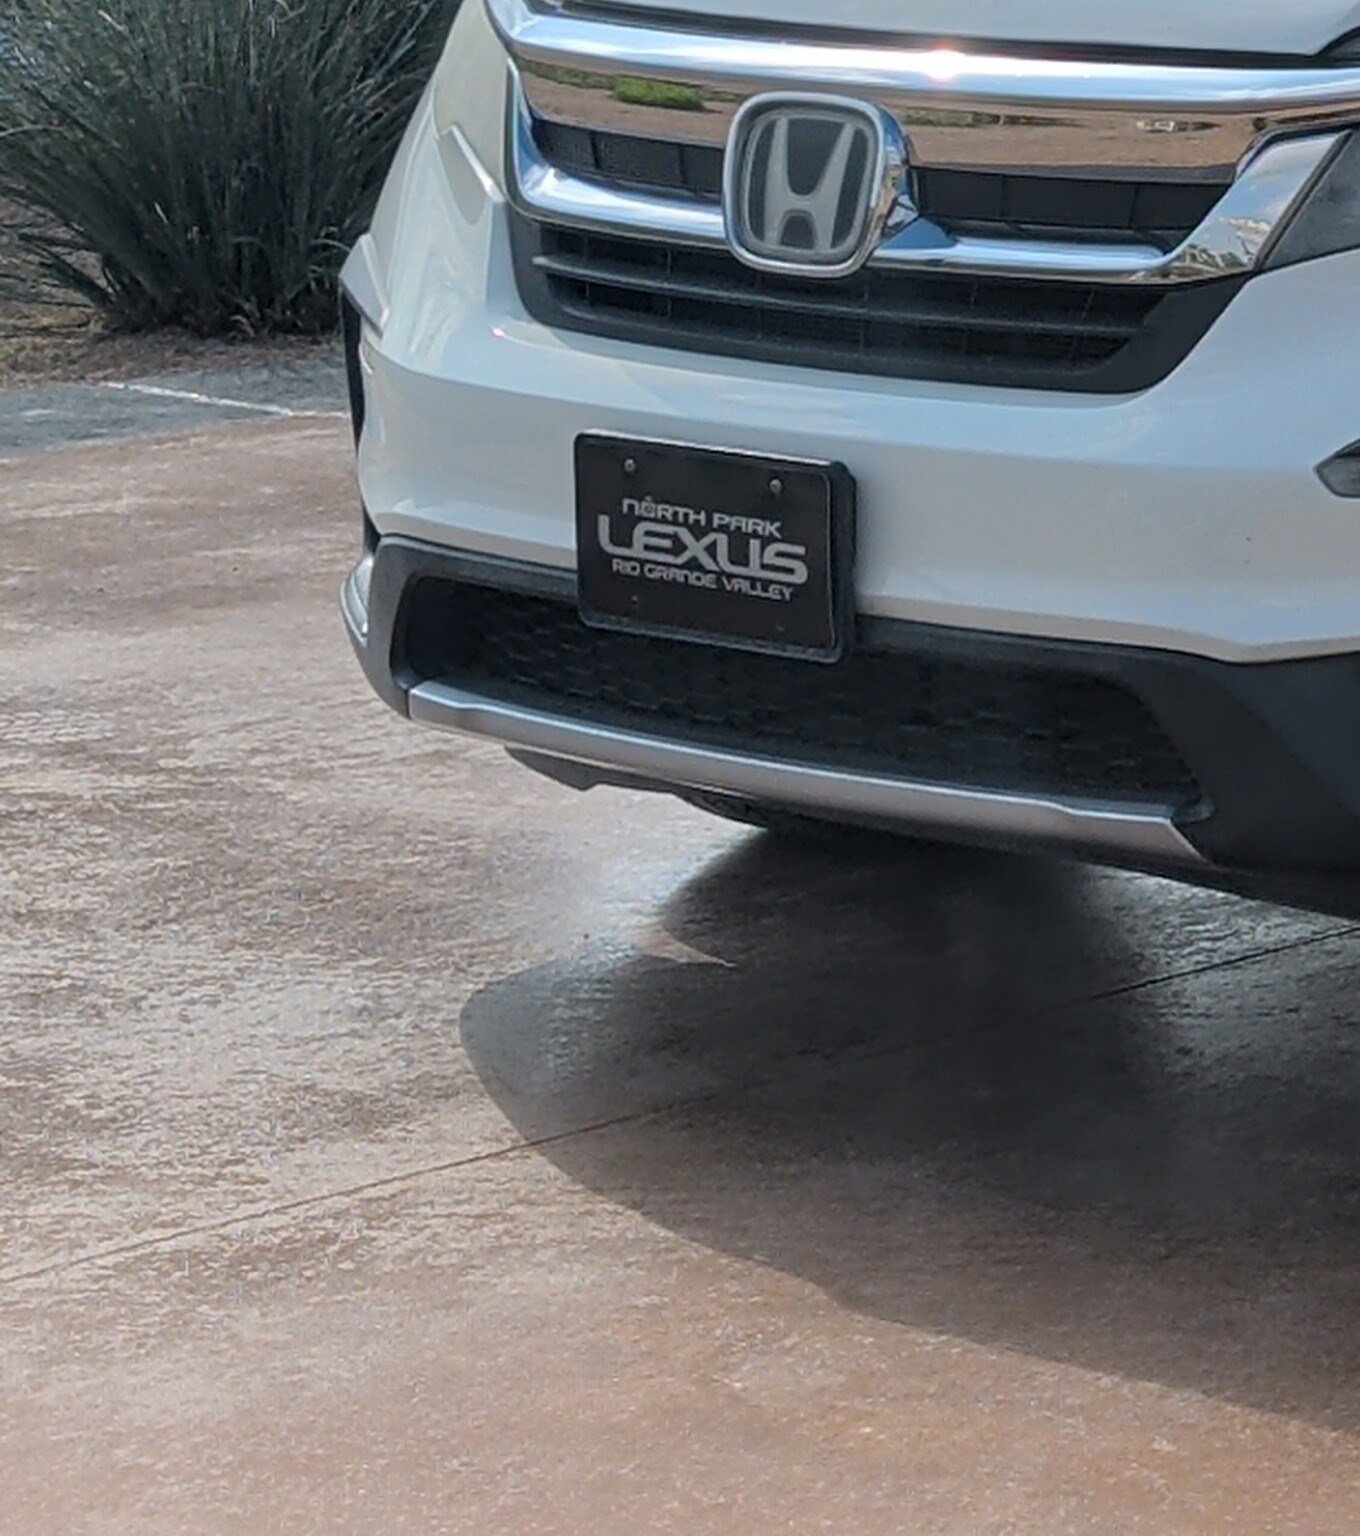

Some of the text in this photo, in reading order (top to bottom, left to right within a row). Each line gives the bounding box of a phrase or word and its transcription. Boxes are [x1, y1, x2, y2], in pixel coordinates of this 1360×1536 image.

[622, 497, 782, 540] NORTH PARK
[598, 514, 808, 585] LEXUS
[611, 558, 795, 602] RIO GRANDE VALLEY
